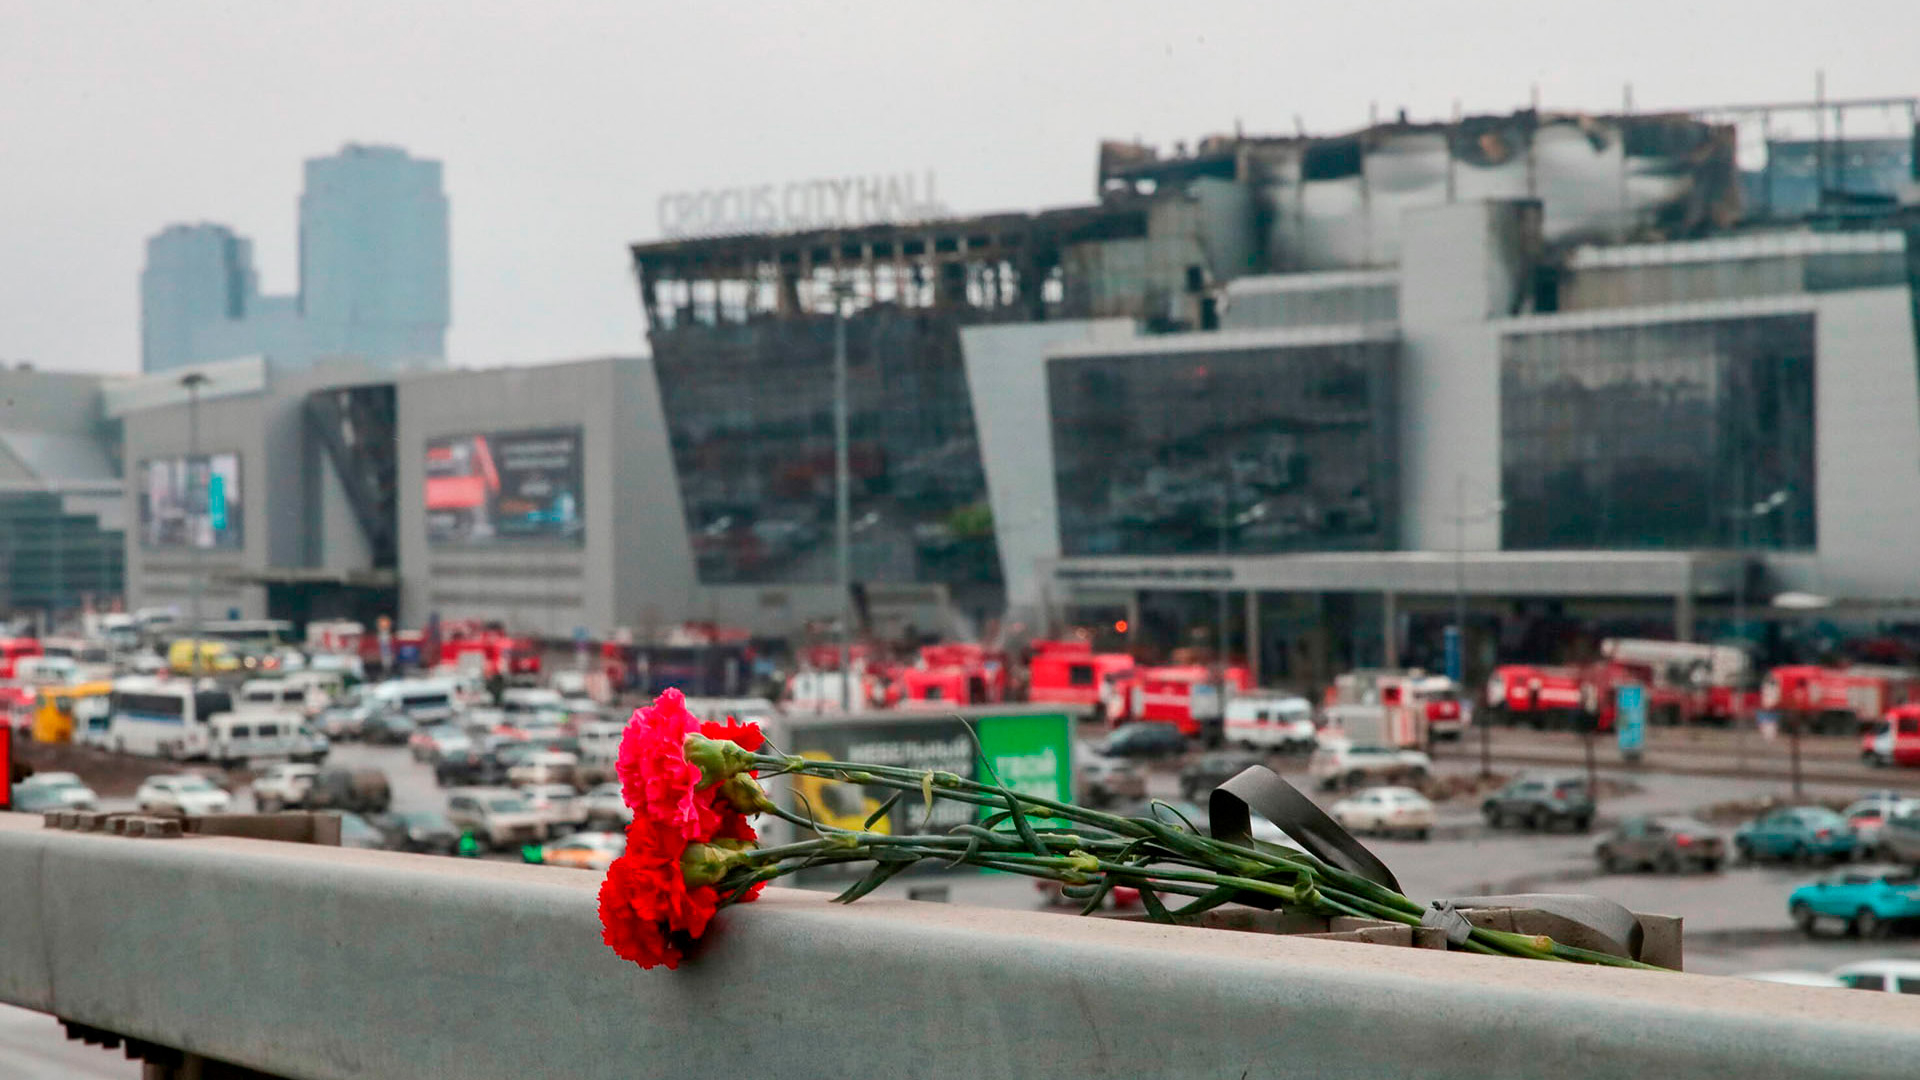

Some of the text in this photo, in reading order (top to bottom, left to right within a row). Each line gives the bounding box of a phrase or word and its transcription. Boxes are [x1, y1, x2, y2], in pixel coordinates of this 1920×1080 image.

[658, 168, 943, 237] CROCUS CITY HALL
